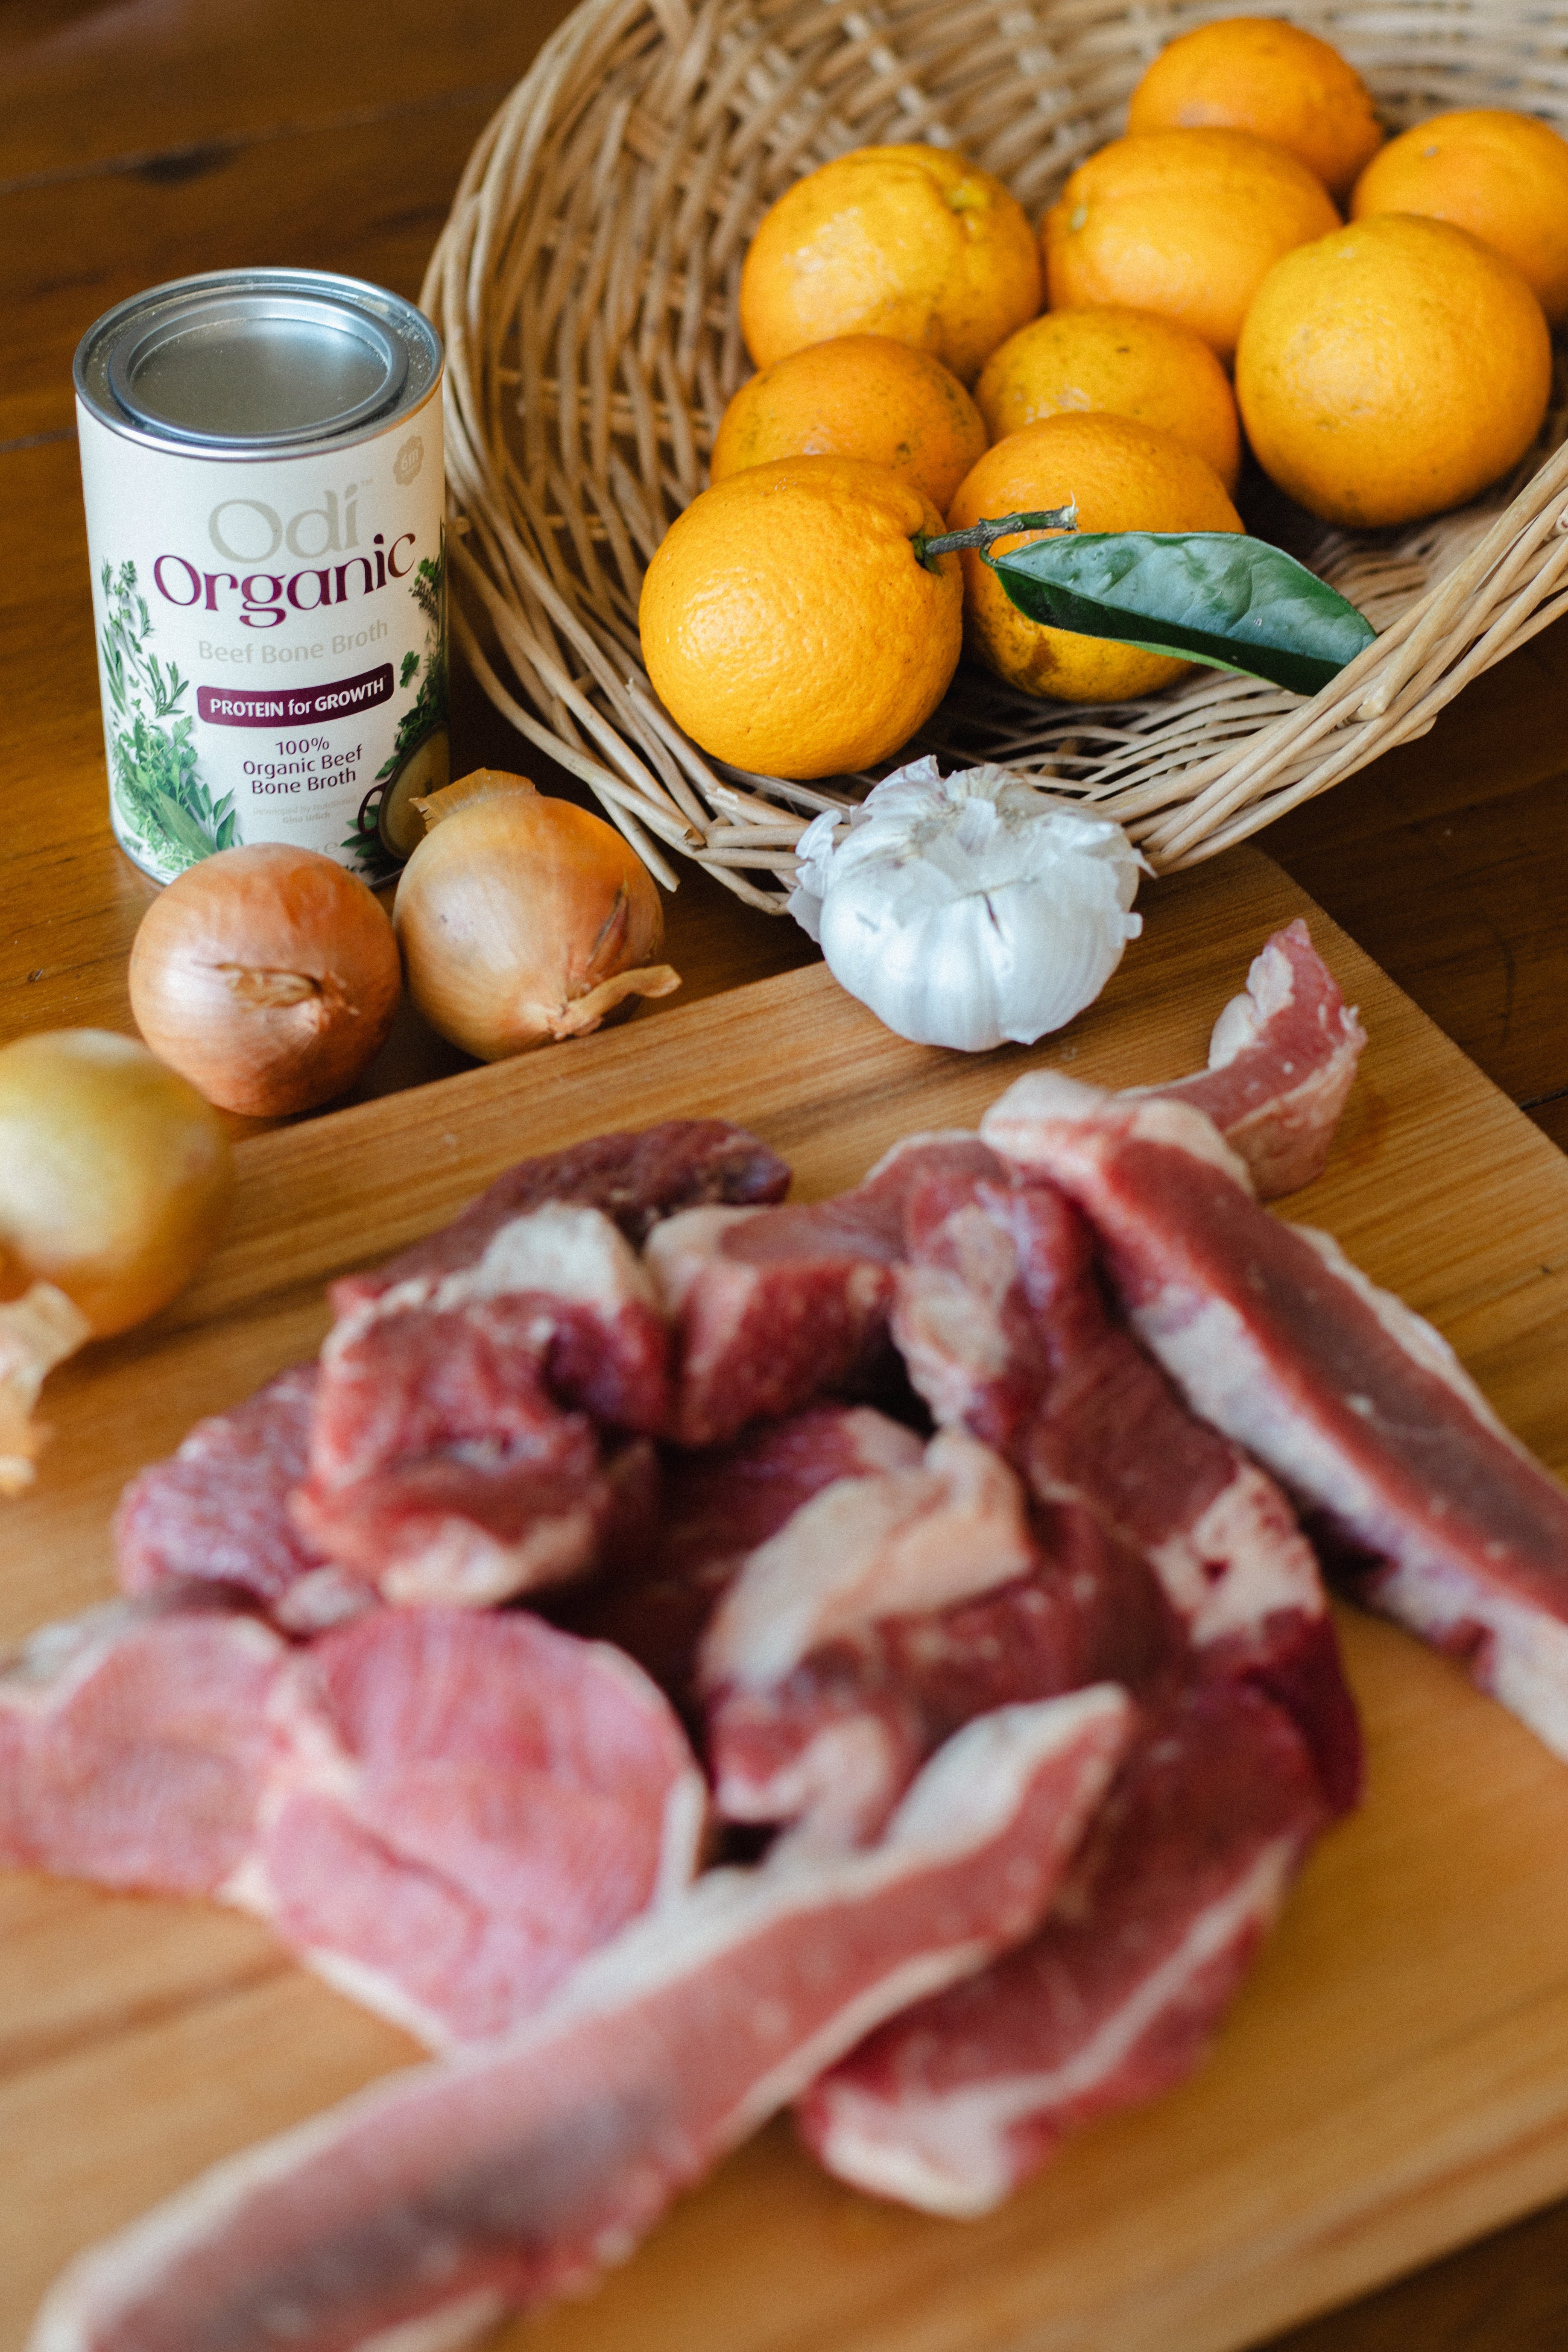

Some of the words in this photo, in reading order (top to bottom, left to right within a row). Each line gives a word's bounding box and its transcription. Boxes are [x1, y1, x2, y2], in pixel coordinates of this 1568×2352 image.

[208, 483, 360, 564] Odi
[154, 533, 416, 628] Organic
[199, 641, 253, 663] Beef
[262, 644, 324, 664] Bone
[331, 619, 388, 655] Broth
[210, 698, 284, 717] PROTEIN
[288, 699, 312, 716] for
[314, 677, 384, 712] GROWTH
[243, 758, 316, 779] Organic
[322, 743, 362, 769] Beef
[275, 736, 330, 755] 100%
[252, 780, 301, 794] Bone
[307, 768, 356, 791] Broth
